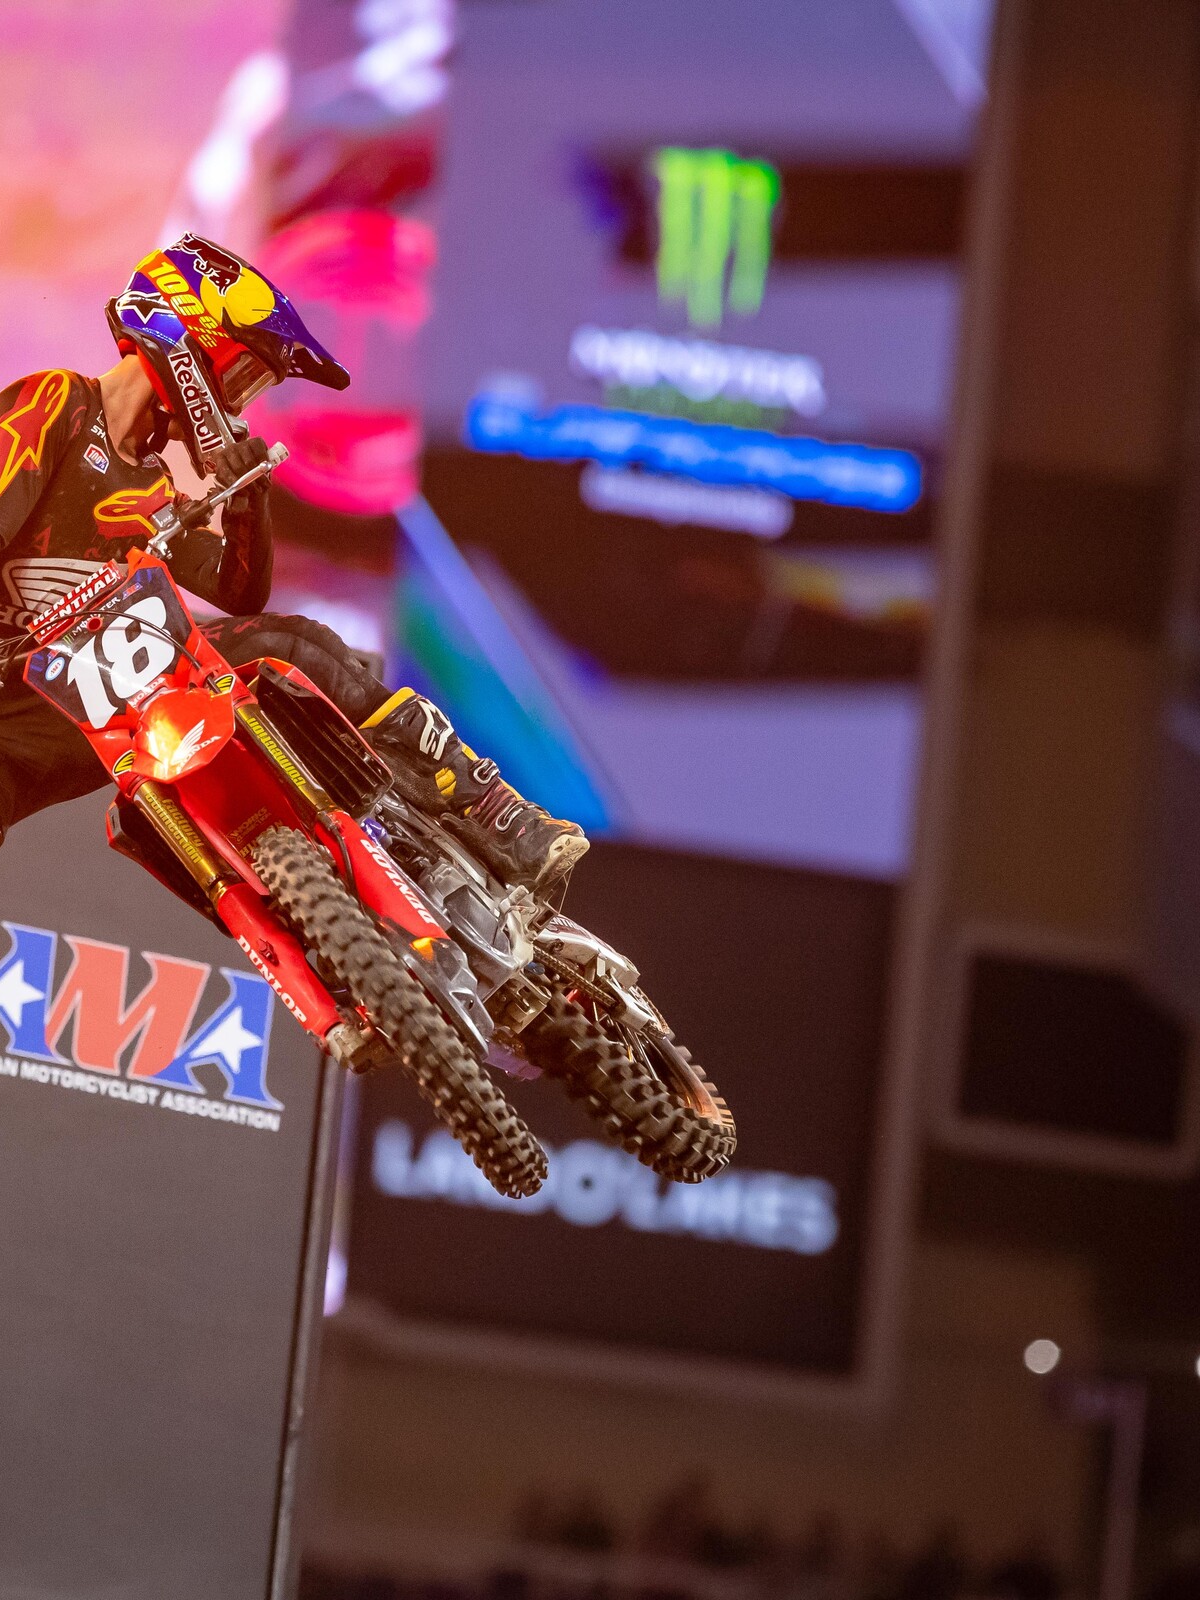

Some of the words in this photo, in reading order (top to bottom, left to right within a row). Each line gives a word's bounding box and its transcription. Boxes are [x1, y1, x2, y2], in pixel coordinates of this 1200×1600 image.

[148, 260, 230, 348] 100%
[66, 596, 176, 730] 18
[359, 839, 440, 928] DUNLOP
[237, 934, 308, 1024] DUNLOP
[19, 1060, 160, 1106] MOTORCYCLIST
[160, 1090, 281, 1132] ASSOCIATION
